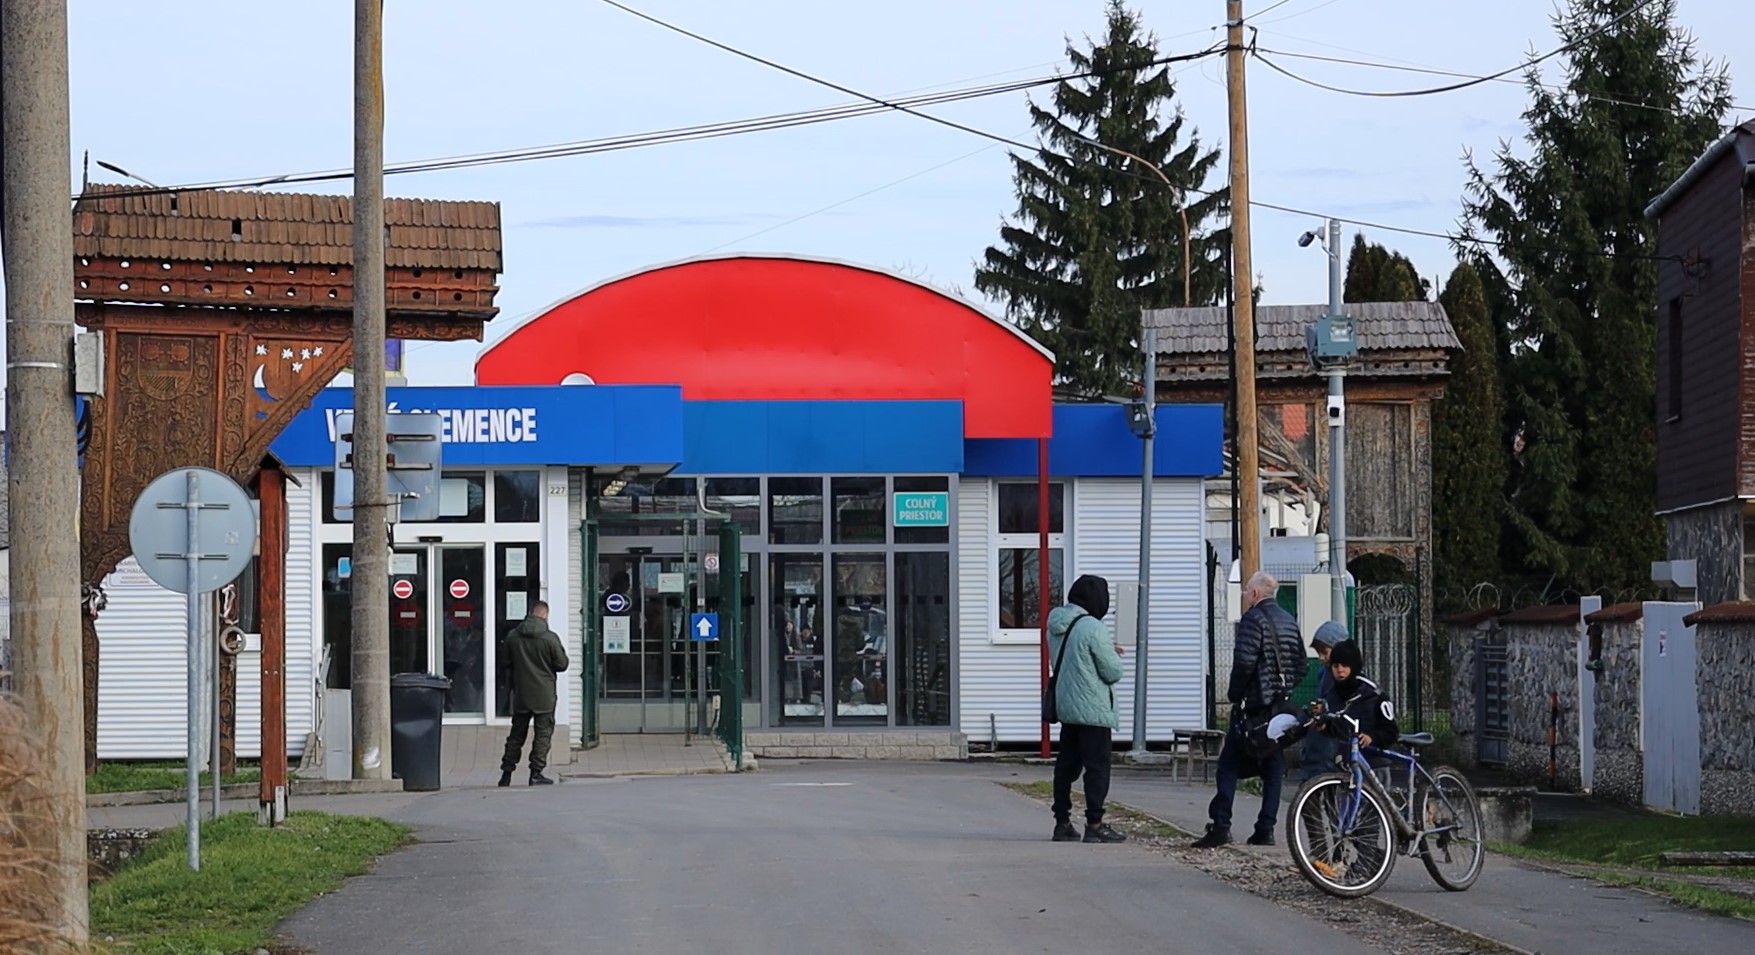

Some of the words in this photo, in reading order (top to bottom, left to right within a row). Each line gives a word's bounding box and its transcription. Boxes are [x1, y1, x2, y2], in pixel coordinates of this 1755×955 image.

[410, 408, 537, 442] EMENCE
[550, 486, 566, 495] 227
[905, 496, 937, 509] COLNÝ
[899, 510, 944, 521] PRIESTOR
